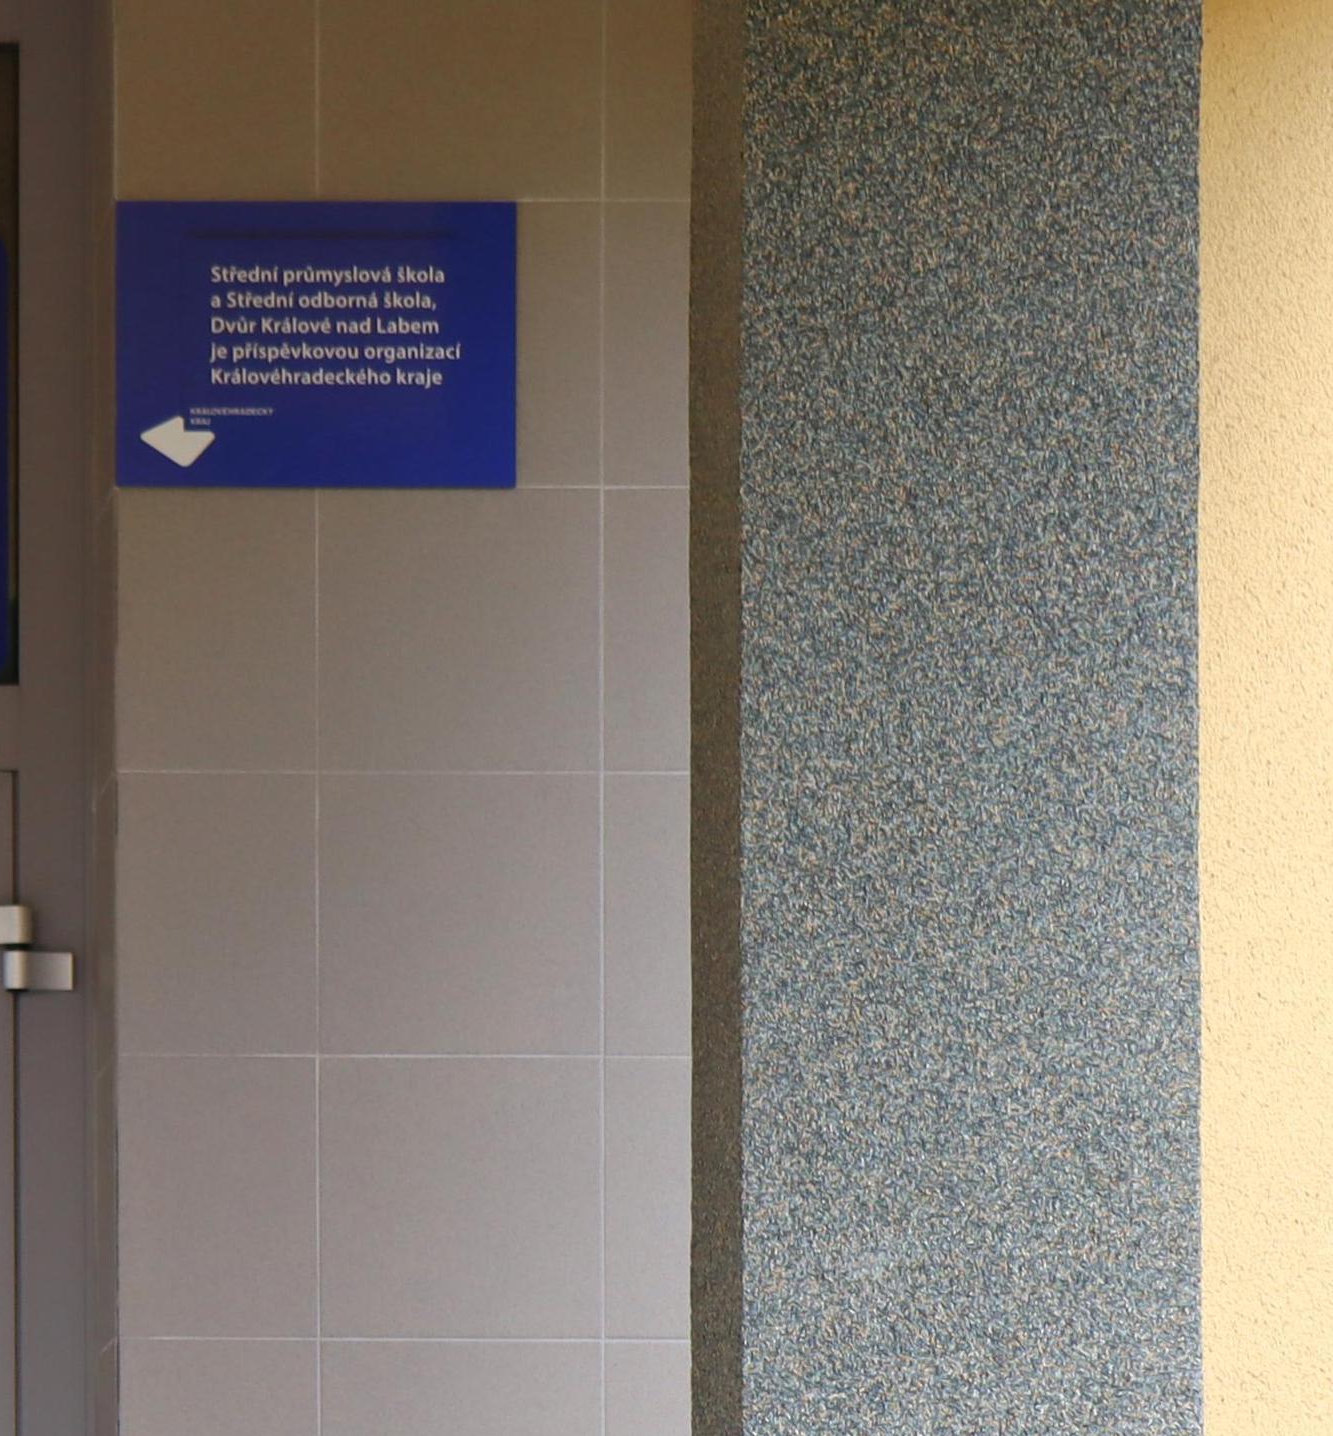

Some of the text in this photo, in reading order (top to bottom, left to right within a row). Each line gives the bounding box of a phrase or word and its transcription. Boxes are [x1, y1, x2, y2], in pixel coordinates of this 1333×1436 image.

[210, 266, 445, 287] Střední průmyslová škola
[210, 291, 436, 311] a Střední odborná škola,
[211, 317, 439, 334] Dvůr Králové nad Labem
[210, 343, 460, 364] je příspěvkovou organizací
[210, 368, 442, 389] Královéhradeckého kraje
